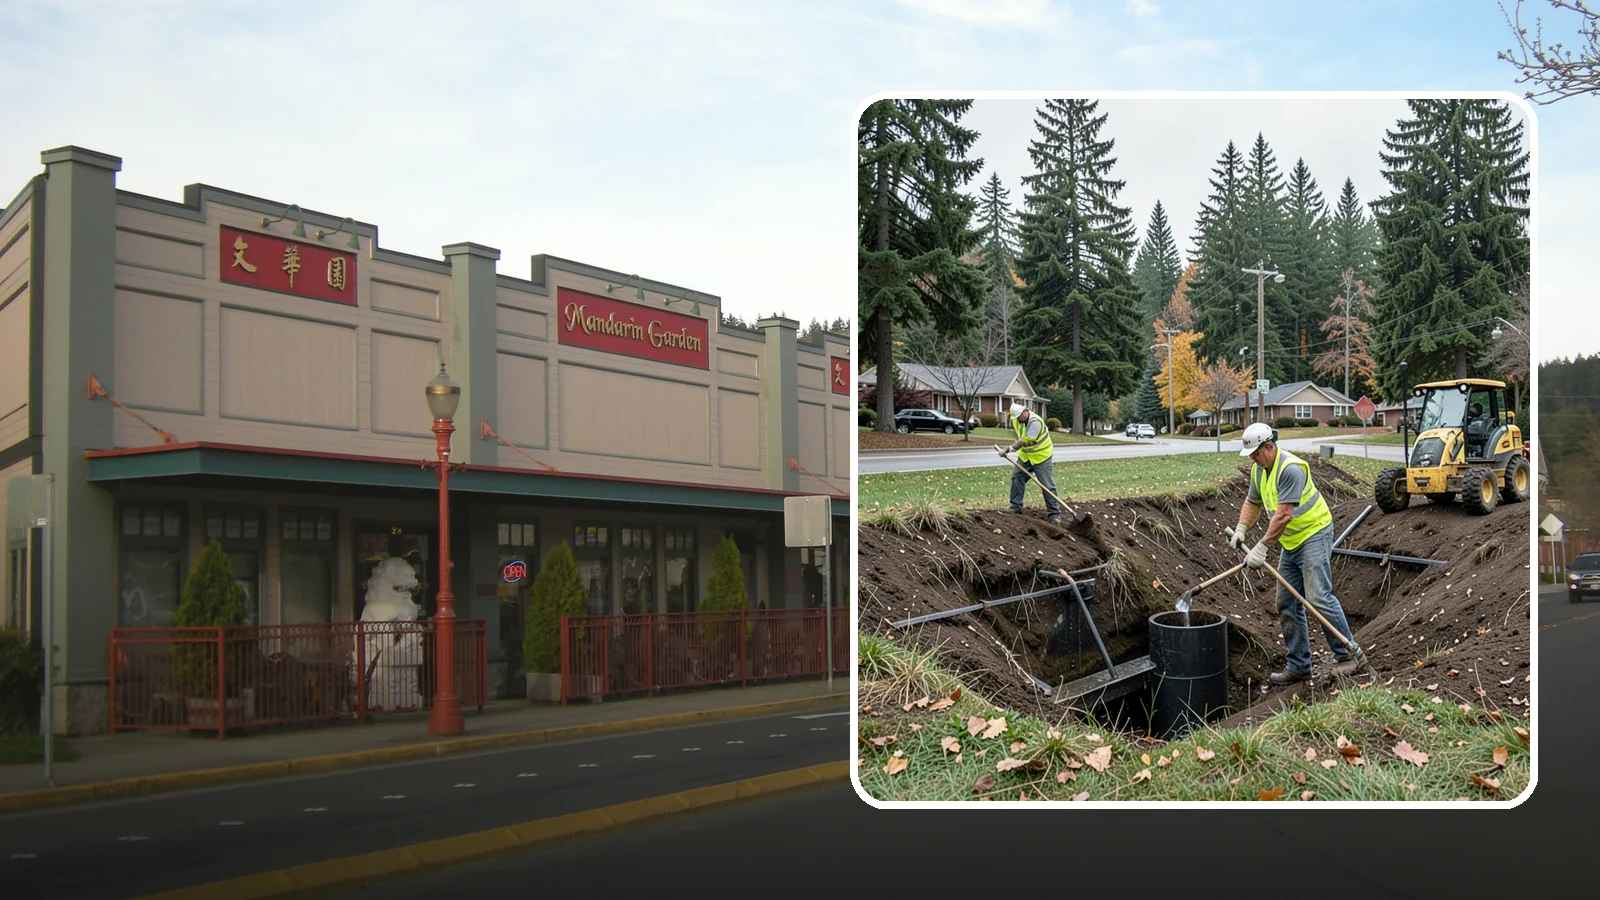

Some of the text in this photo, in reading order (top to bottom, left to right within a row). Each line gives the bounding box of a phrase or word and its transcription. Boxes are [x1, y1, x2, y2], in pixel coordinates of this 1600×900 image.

[231, 235, 346, 291] 文華園
[564, 302, 702, 352] Mandarin Garden
[503, 565, 527, 578] OPEN
